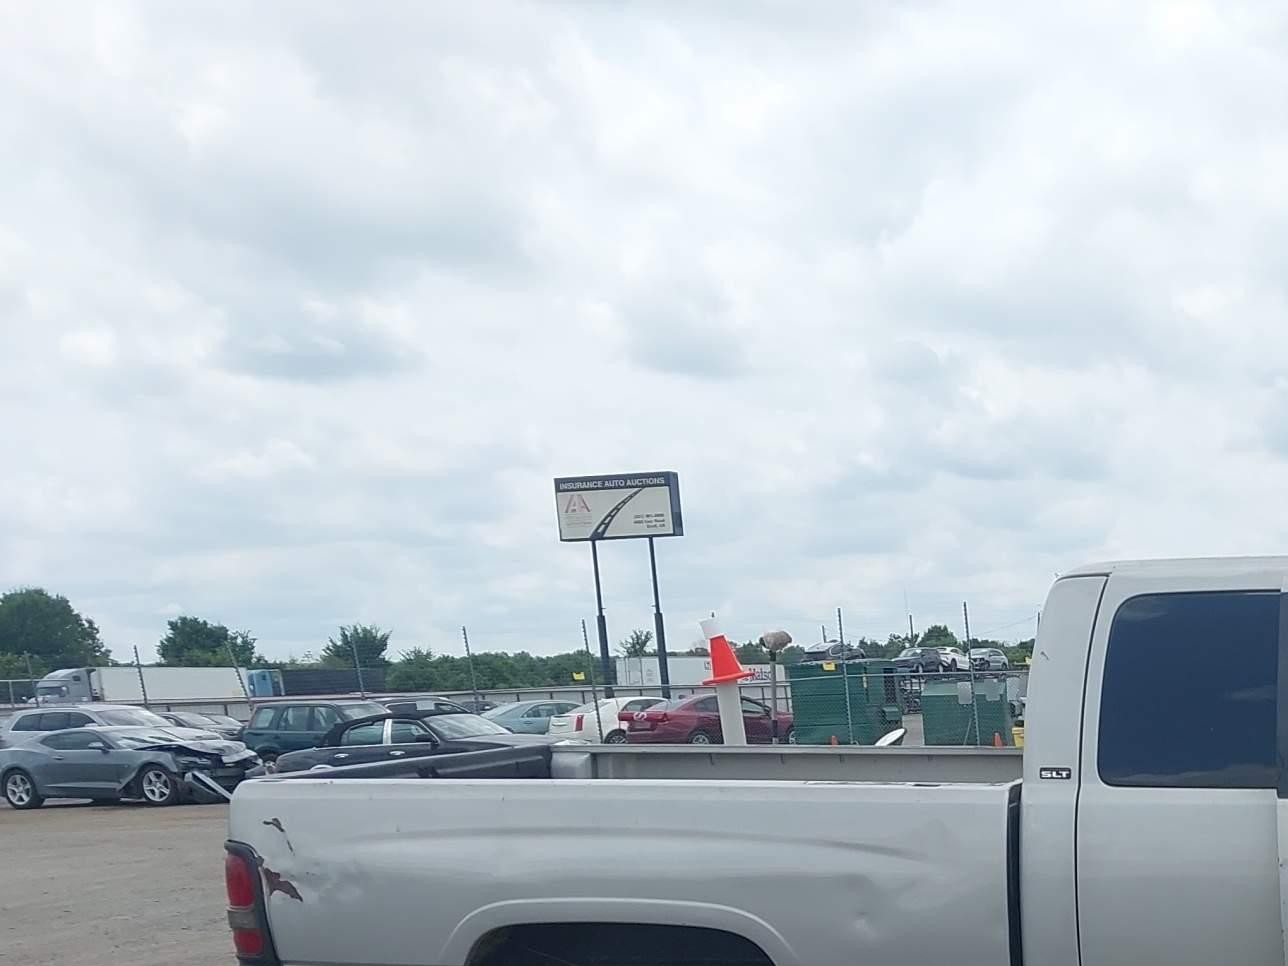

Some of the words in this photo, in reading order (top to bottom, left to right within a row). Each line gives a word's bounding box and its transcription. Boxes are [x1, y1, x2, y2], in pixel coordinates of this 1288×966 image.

[559, 480, 603, 490] INSURANCE
[604, 479, 625, 488] AUTO
[626, 477, 665, 487] AUCTIONS
[1041, 770, 1070, 778] SLT
